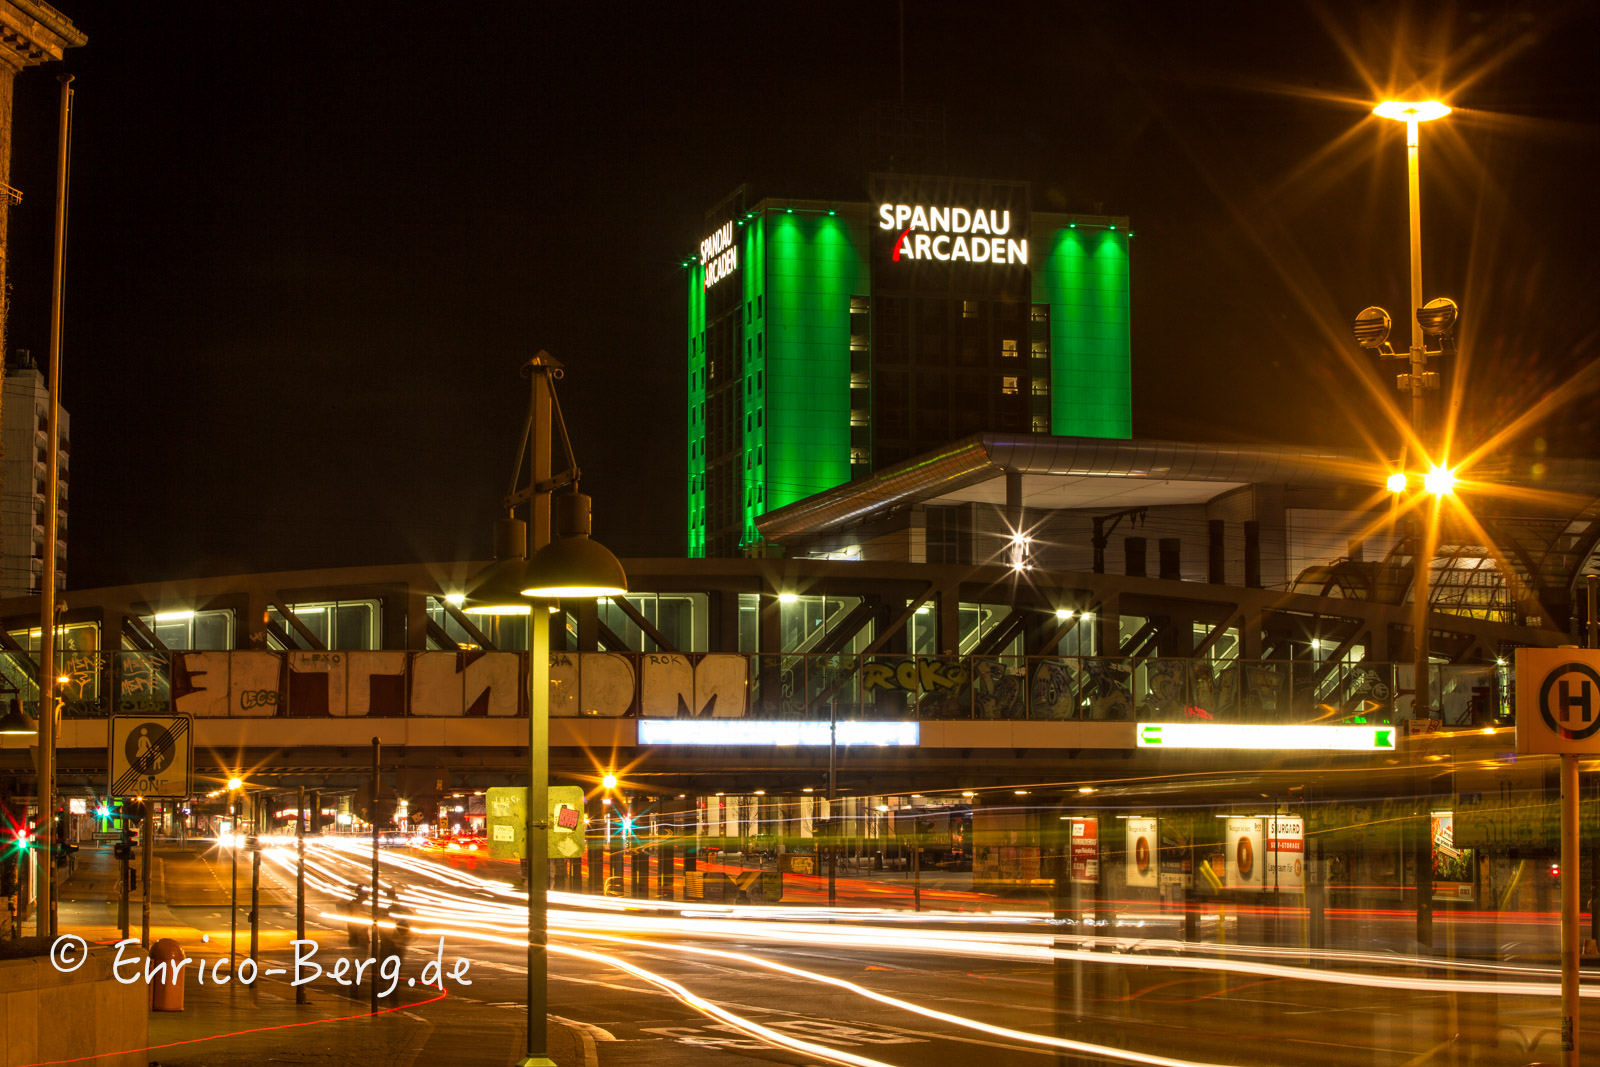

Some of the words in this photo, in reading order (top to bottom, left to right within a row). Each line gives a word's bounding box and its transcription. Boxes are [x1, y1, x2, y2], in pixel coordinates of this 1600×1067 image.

[879, 203, 1010, 235] SPANDAU
[700, 220, 733, 266] SPANDAU
[892, 226, 1028, 265] ARCADEN
[704, 245, 737, 293] ARCADEN
[650, 655, 682, 666] ROK
[1558, 680, 1592, 722] H
[1271, 823, 1300, 834] SURGARD
